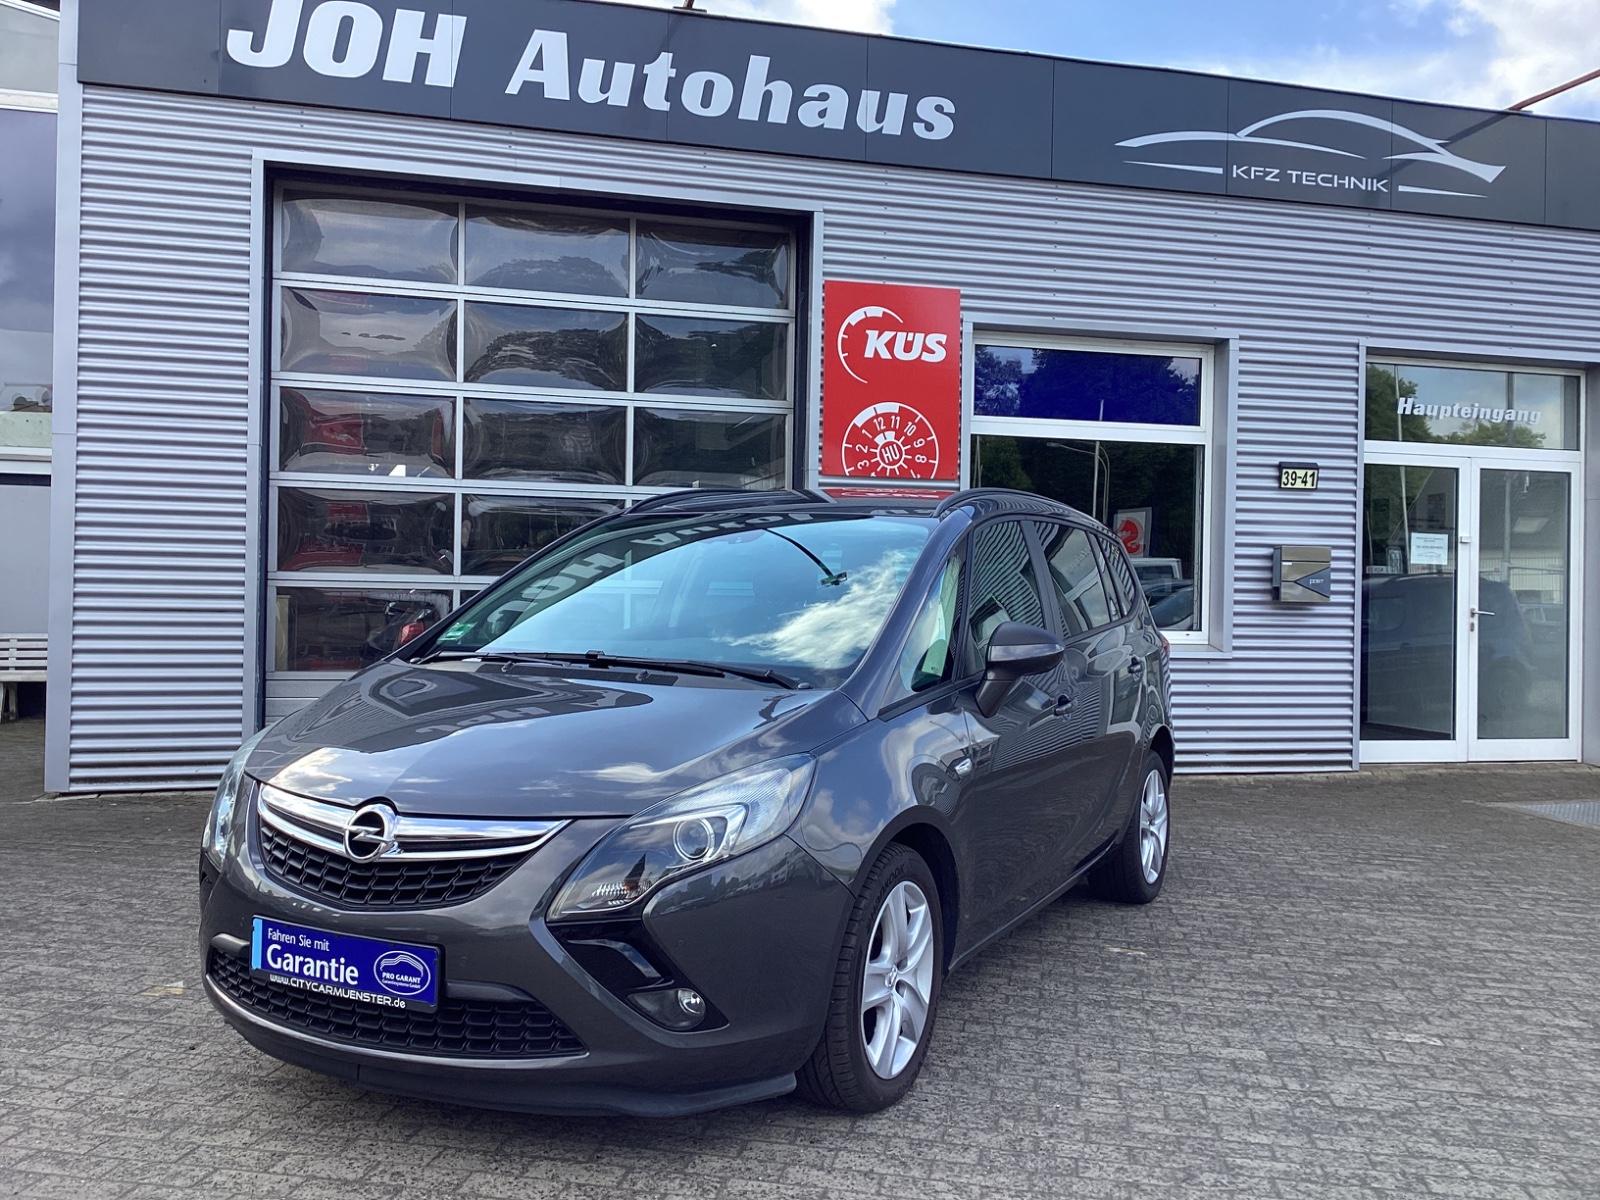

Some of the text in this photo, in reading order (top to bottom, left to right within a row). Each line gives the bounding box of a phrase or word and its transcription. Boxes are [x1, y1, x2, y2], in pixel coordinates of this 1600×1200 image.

[227, 0, 957, 140] JOH Autohaus
[1232, 164, 1389, 193] KFZ TECHNIK
[864, 329, 948, 363] KÜS
[1397, 397, 1542, 425] Haupteingang
[873, 416, 886, 431] 12
[890, 415, 901, 430] 11
[903, 421, 917, 437] 10
[861, 428, 873, 439] 1
[855, 444, 868, 454] 2
[881, 443, 900, 464] HU
[856, 459, 870, 470] 3
[914, 454, 928, 463] 8
[1282, 470, 1316, 487] 39-41
[267, 927, 330, 951] Fahren Sie mit
[266, 943, 359, 985] Garantie
[382, 971, 421, 984] PRO GARANT
[269, 973, 406, 1009] www.CITYCARMUENSTER.de
